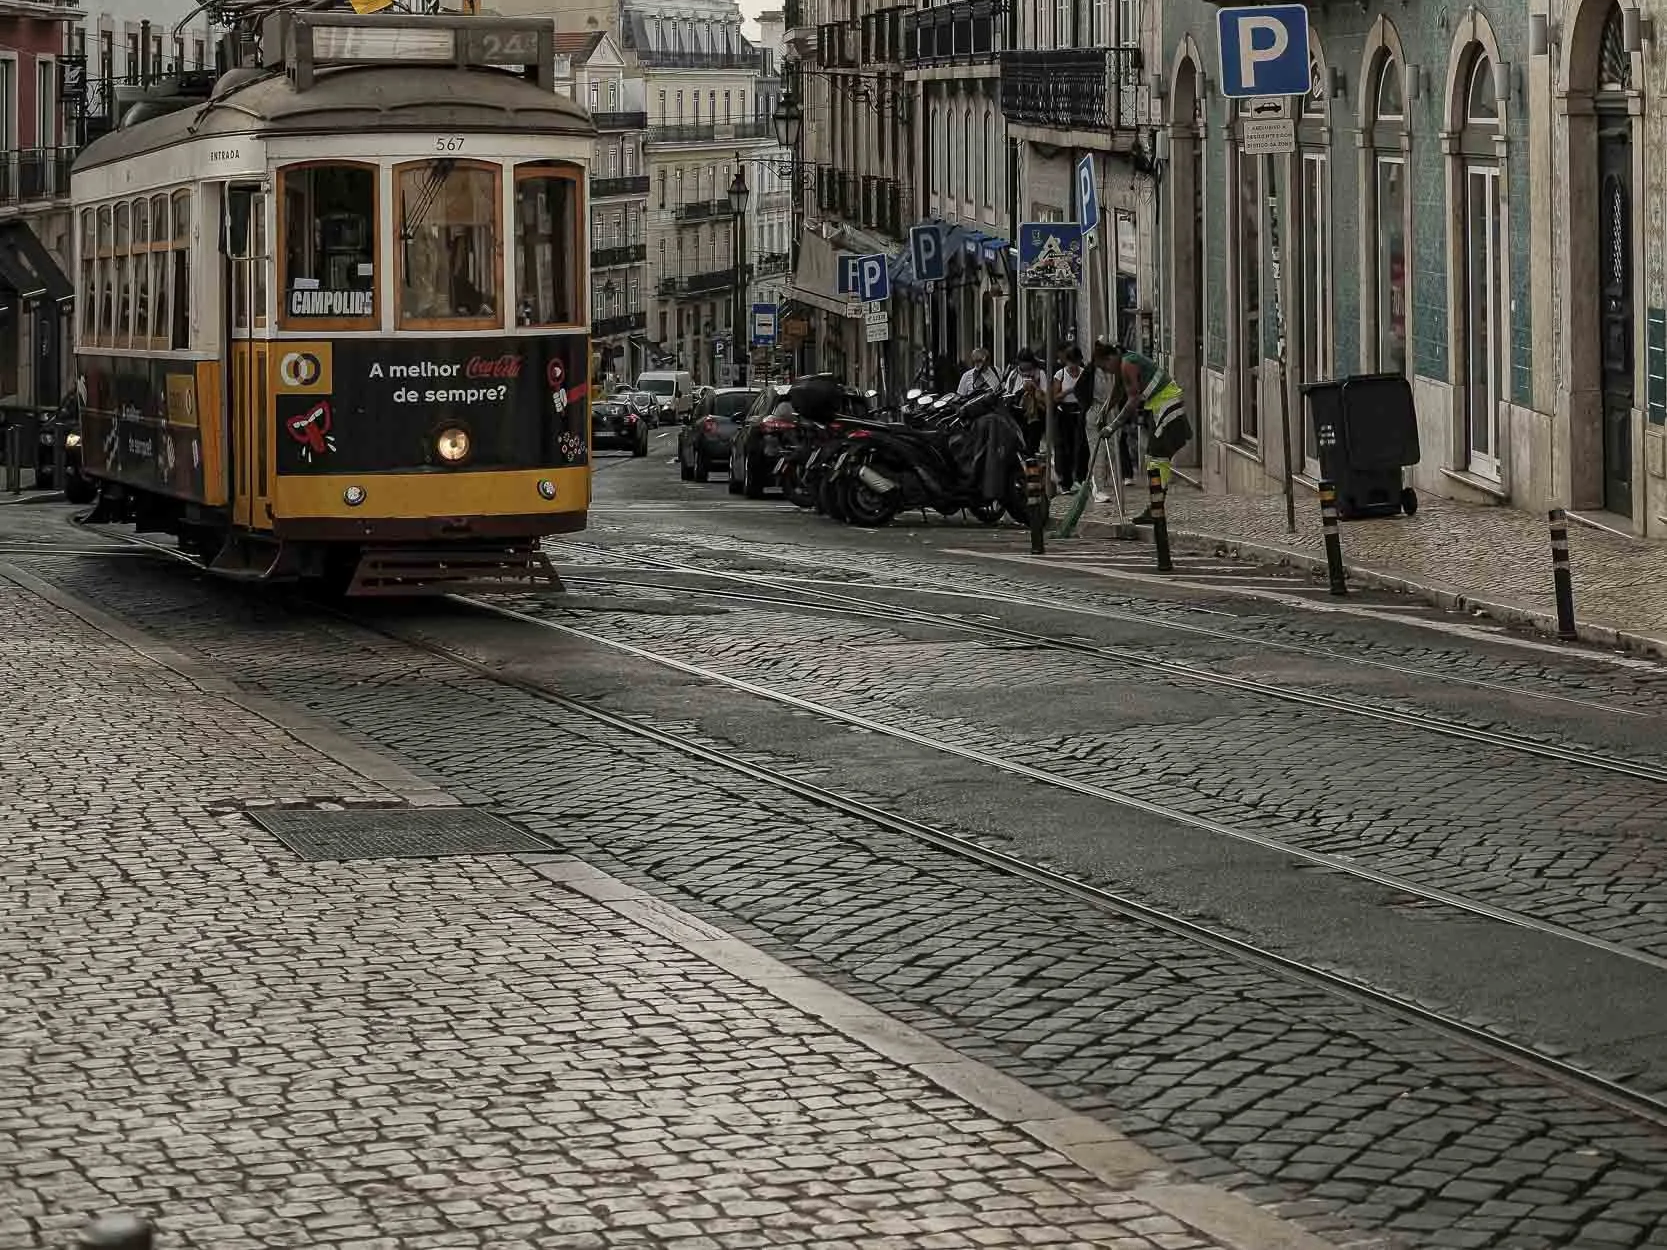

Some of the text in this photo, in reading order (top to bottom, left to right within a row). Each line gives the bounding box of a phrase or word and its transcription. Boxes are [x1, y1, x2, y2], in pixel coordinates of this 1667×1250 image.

[1238, 15, 1289, 88] P
[210, 149, 240, 162] ENTRADA
[435, 138, 465, 151] 567
[1080, 166, 1091, 226] P
[919, 232, 936, 275] P
[863, 260, 881, 298] P
[292, 291, 373, 315] CAMPOLIDE
[716, 343, 724, 354] P
[369, 362, 384, 378] A
[389, 361, 461, 378] melhor
[393, 385, 507, 405] de sempre?
